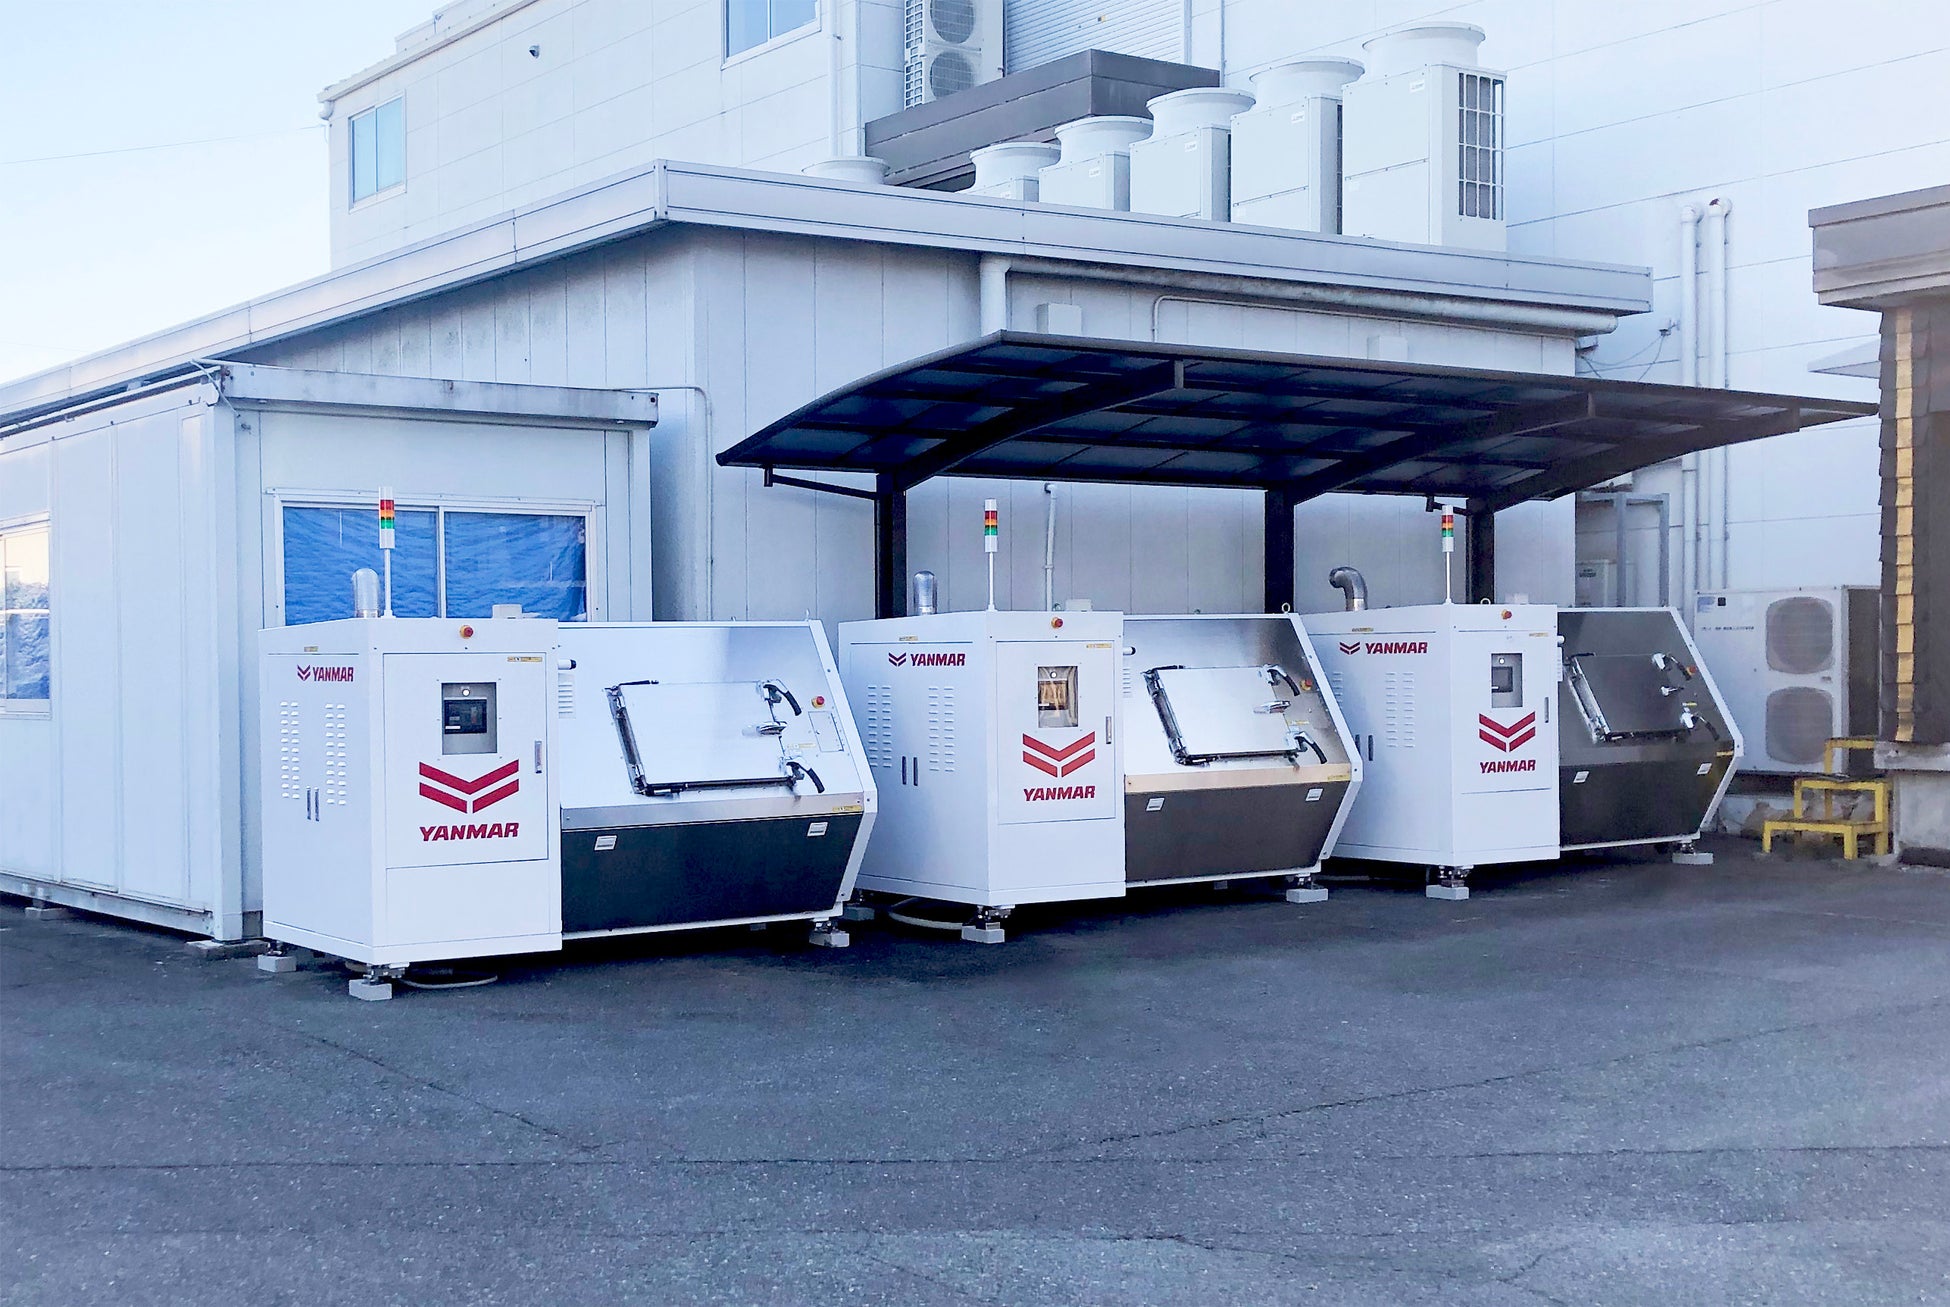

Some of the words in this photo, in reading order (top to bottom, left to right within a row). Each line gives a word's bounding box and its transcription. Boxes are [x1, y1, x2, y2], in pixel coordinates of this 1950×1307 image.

[1365, 641, 1428, 655] YANMAR
[910, 653, 965, 667] YANMAR
[313, 666, 354, 682] YANMAR
[1480, 759, 1536, 774] YANMAR
[1023, 785, 1096, 802] YANMAR
[420, 822, 519, 842] YANMAR
